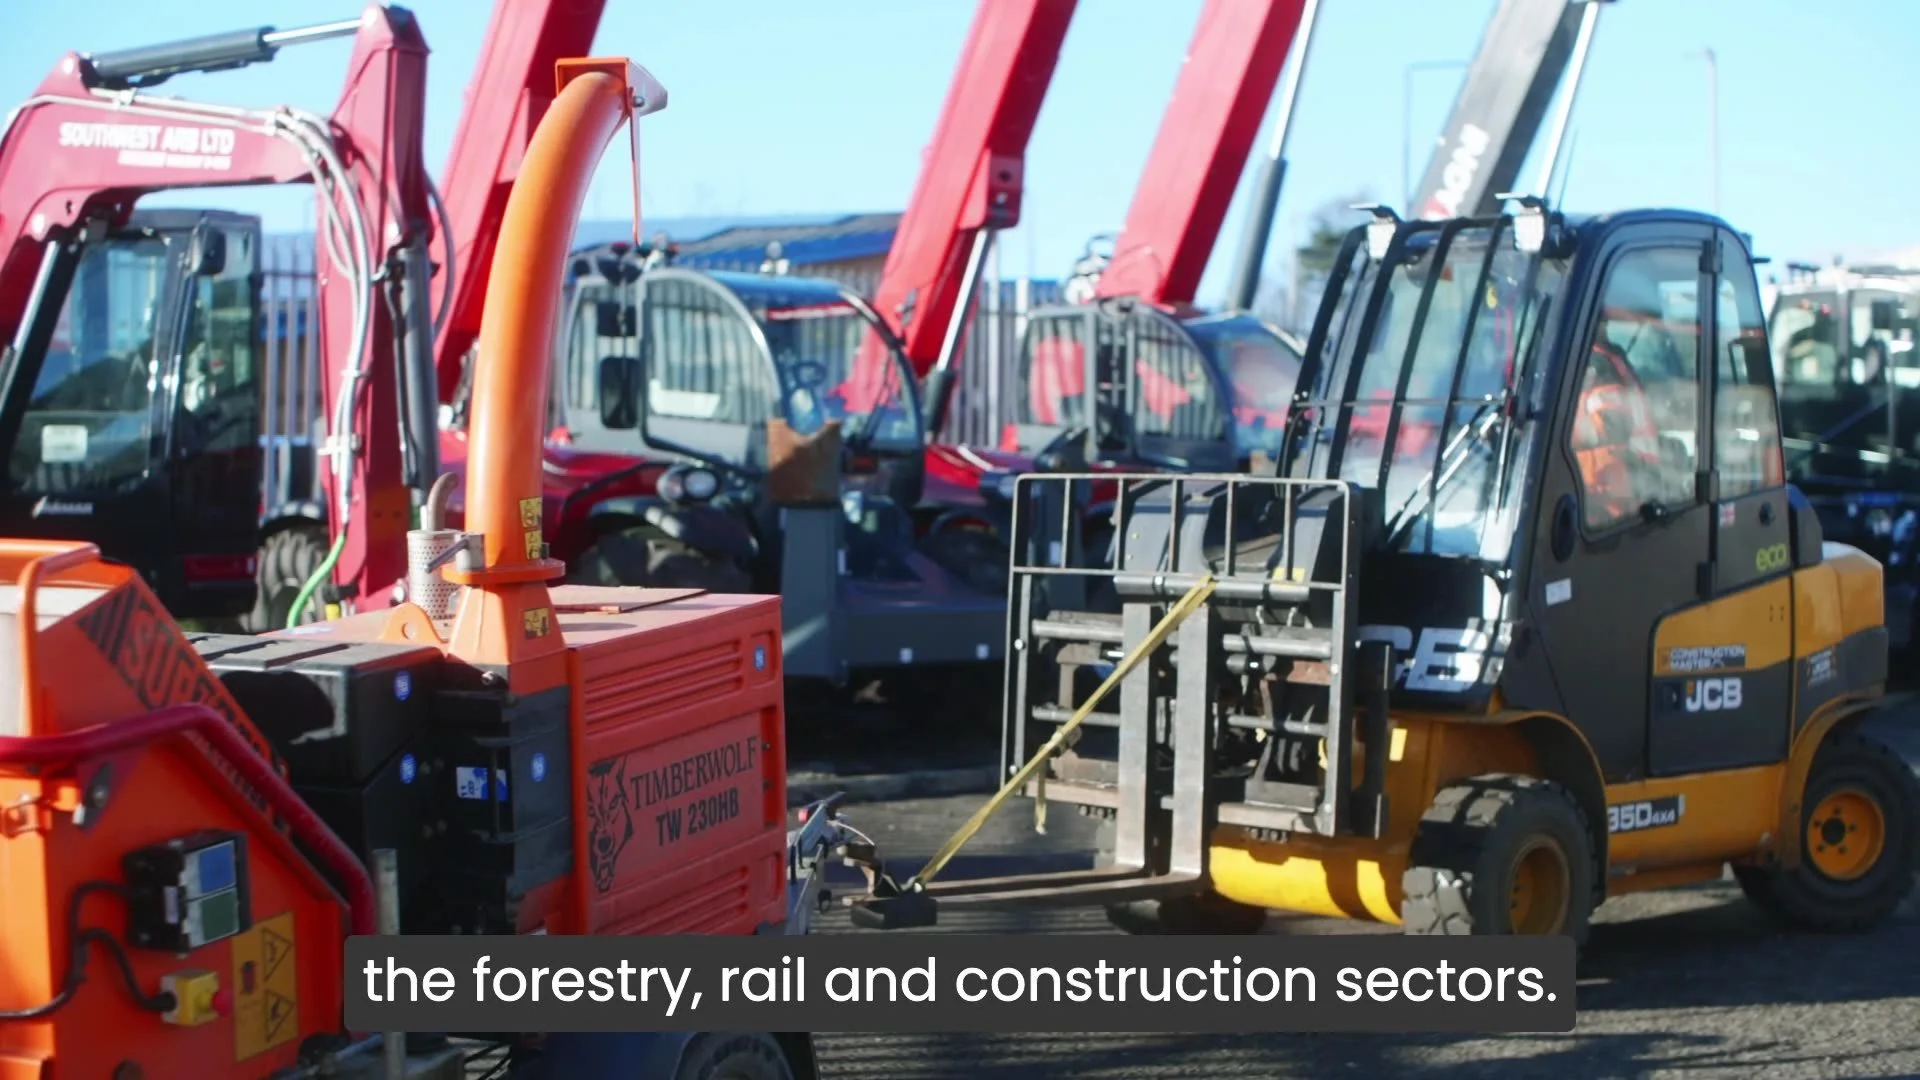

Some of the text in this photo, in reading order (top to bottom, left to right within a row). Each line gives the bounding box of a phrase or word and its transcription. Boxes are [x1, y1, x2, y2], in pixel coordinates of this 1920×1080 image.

[1685, 676, 1743, 713] JCB
[630, 736, 757, 811] TIMBERWOLF
[656, 787, 740, 847] TW 230HB
